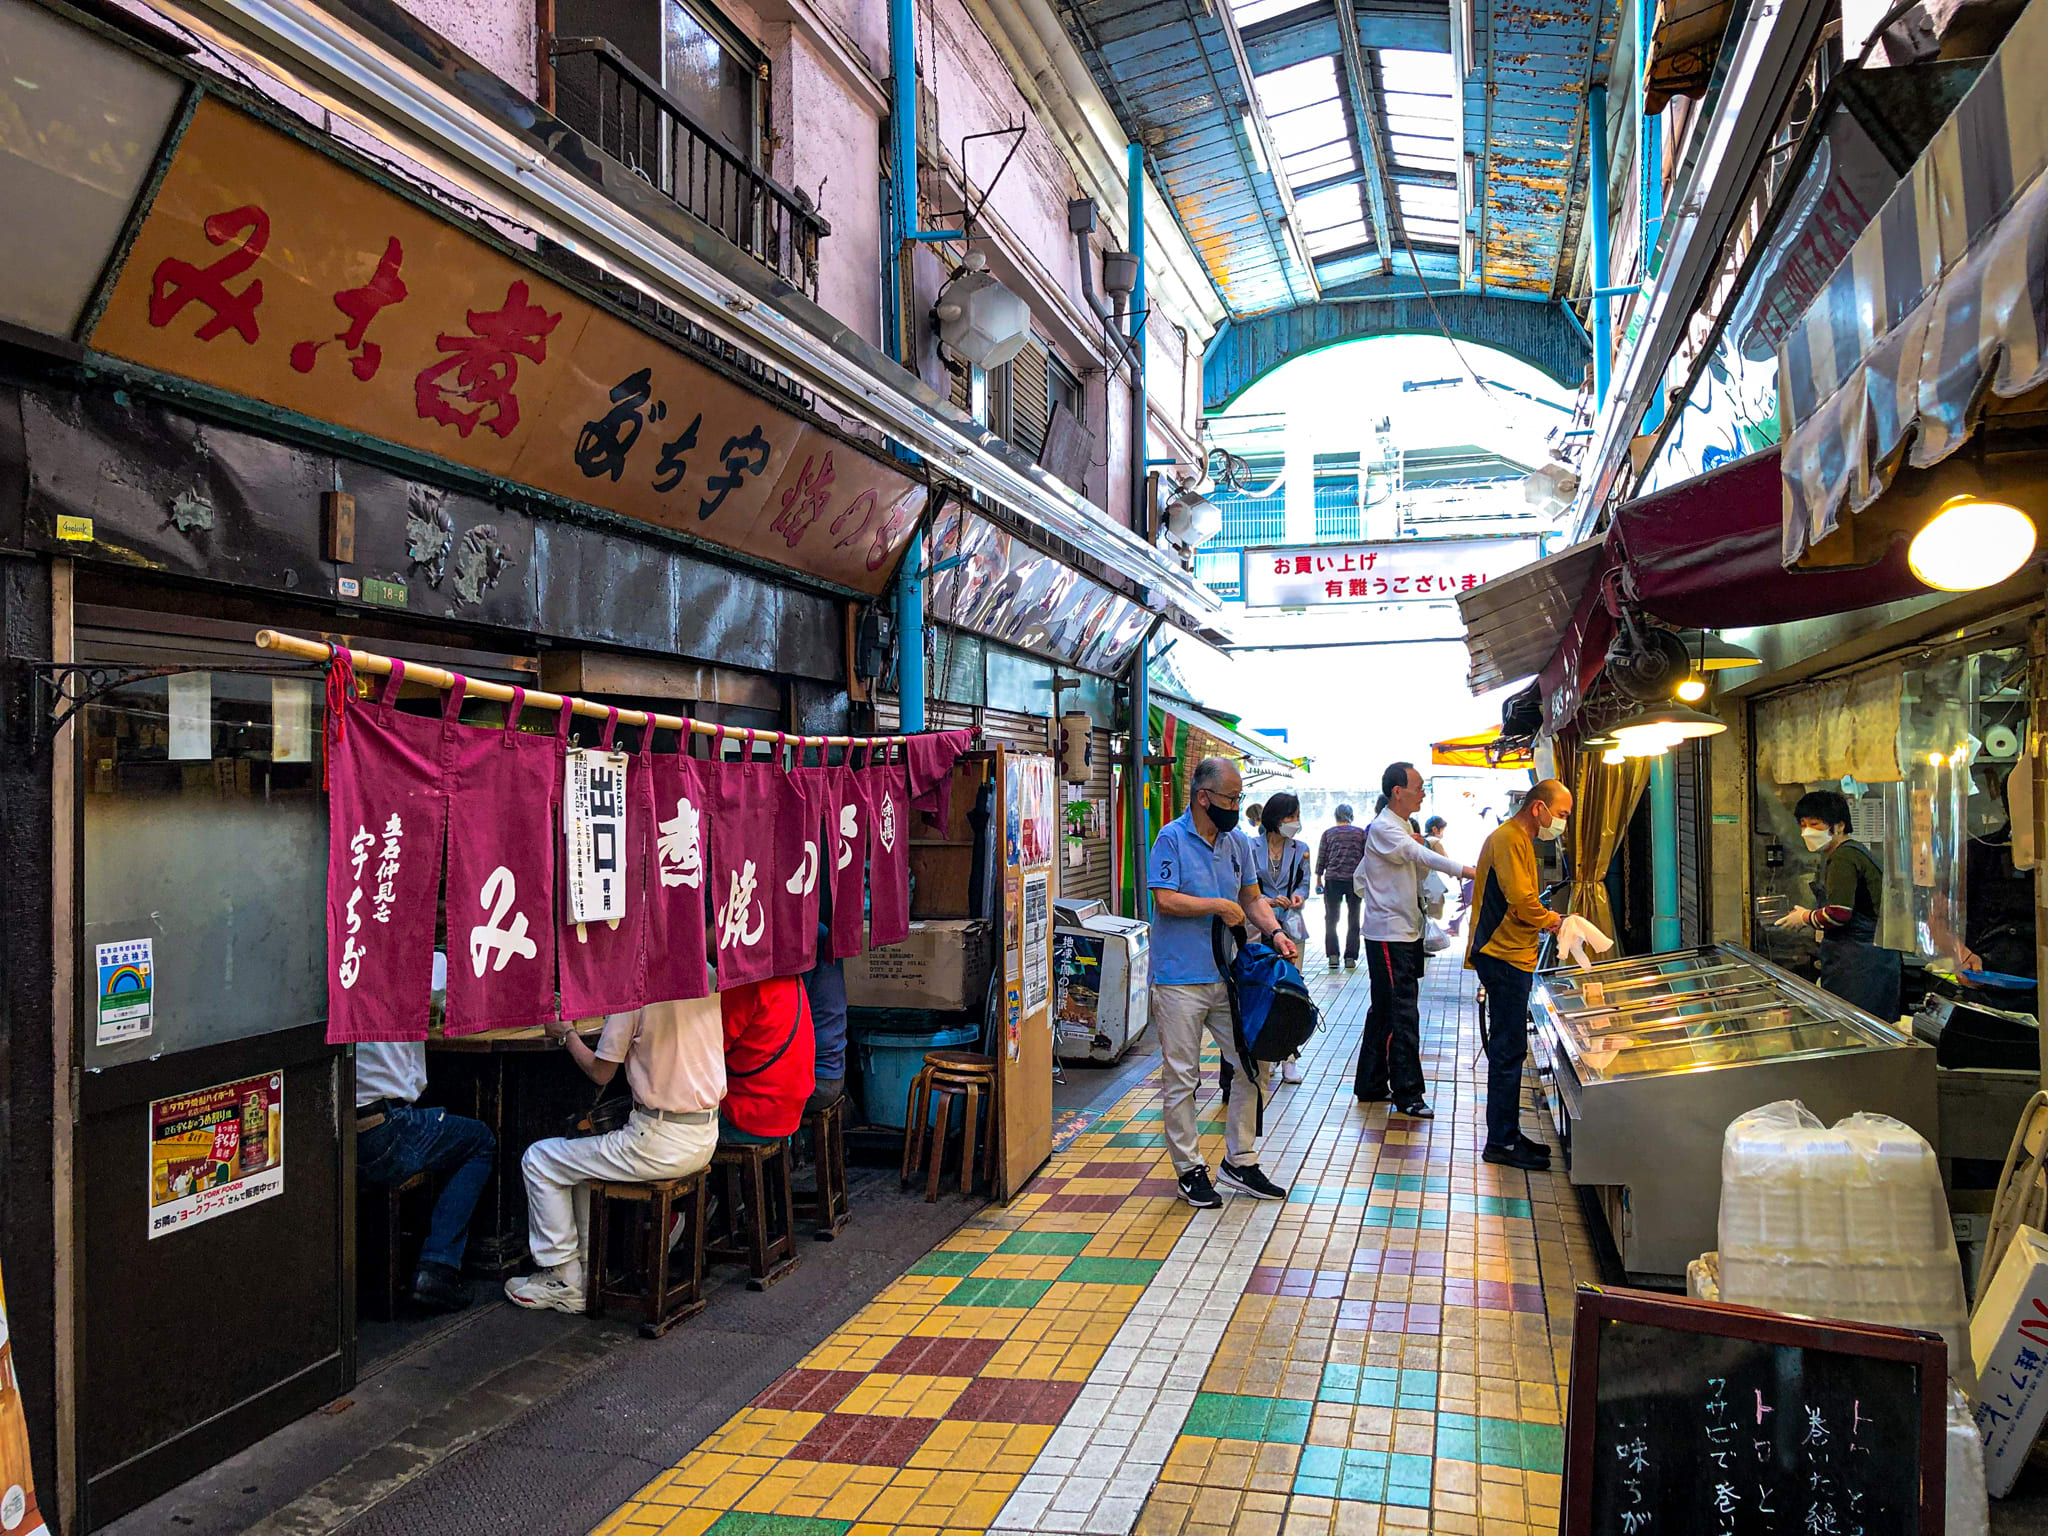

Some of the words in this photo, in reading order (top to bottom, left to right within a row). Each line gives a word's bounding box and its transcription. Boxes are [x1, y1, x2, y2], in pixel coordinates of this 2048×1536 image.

[1274, 552, 1378, 575] お買い上げ
[383, 586, 405, 602] 18-8
[589, 766, 617, 874] 出口
[1160, 860, 1173, 880] 3
[203, 1189, 220, 1200] YORK
[221, 1182, 244, 1194] FOODS
[1705, 1377, 1742, 1536] ワサビで巻い
